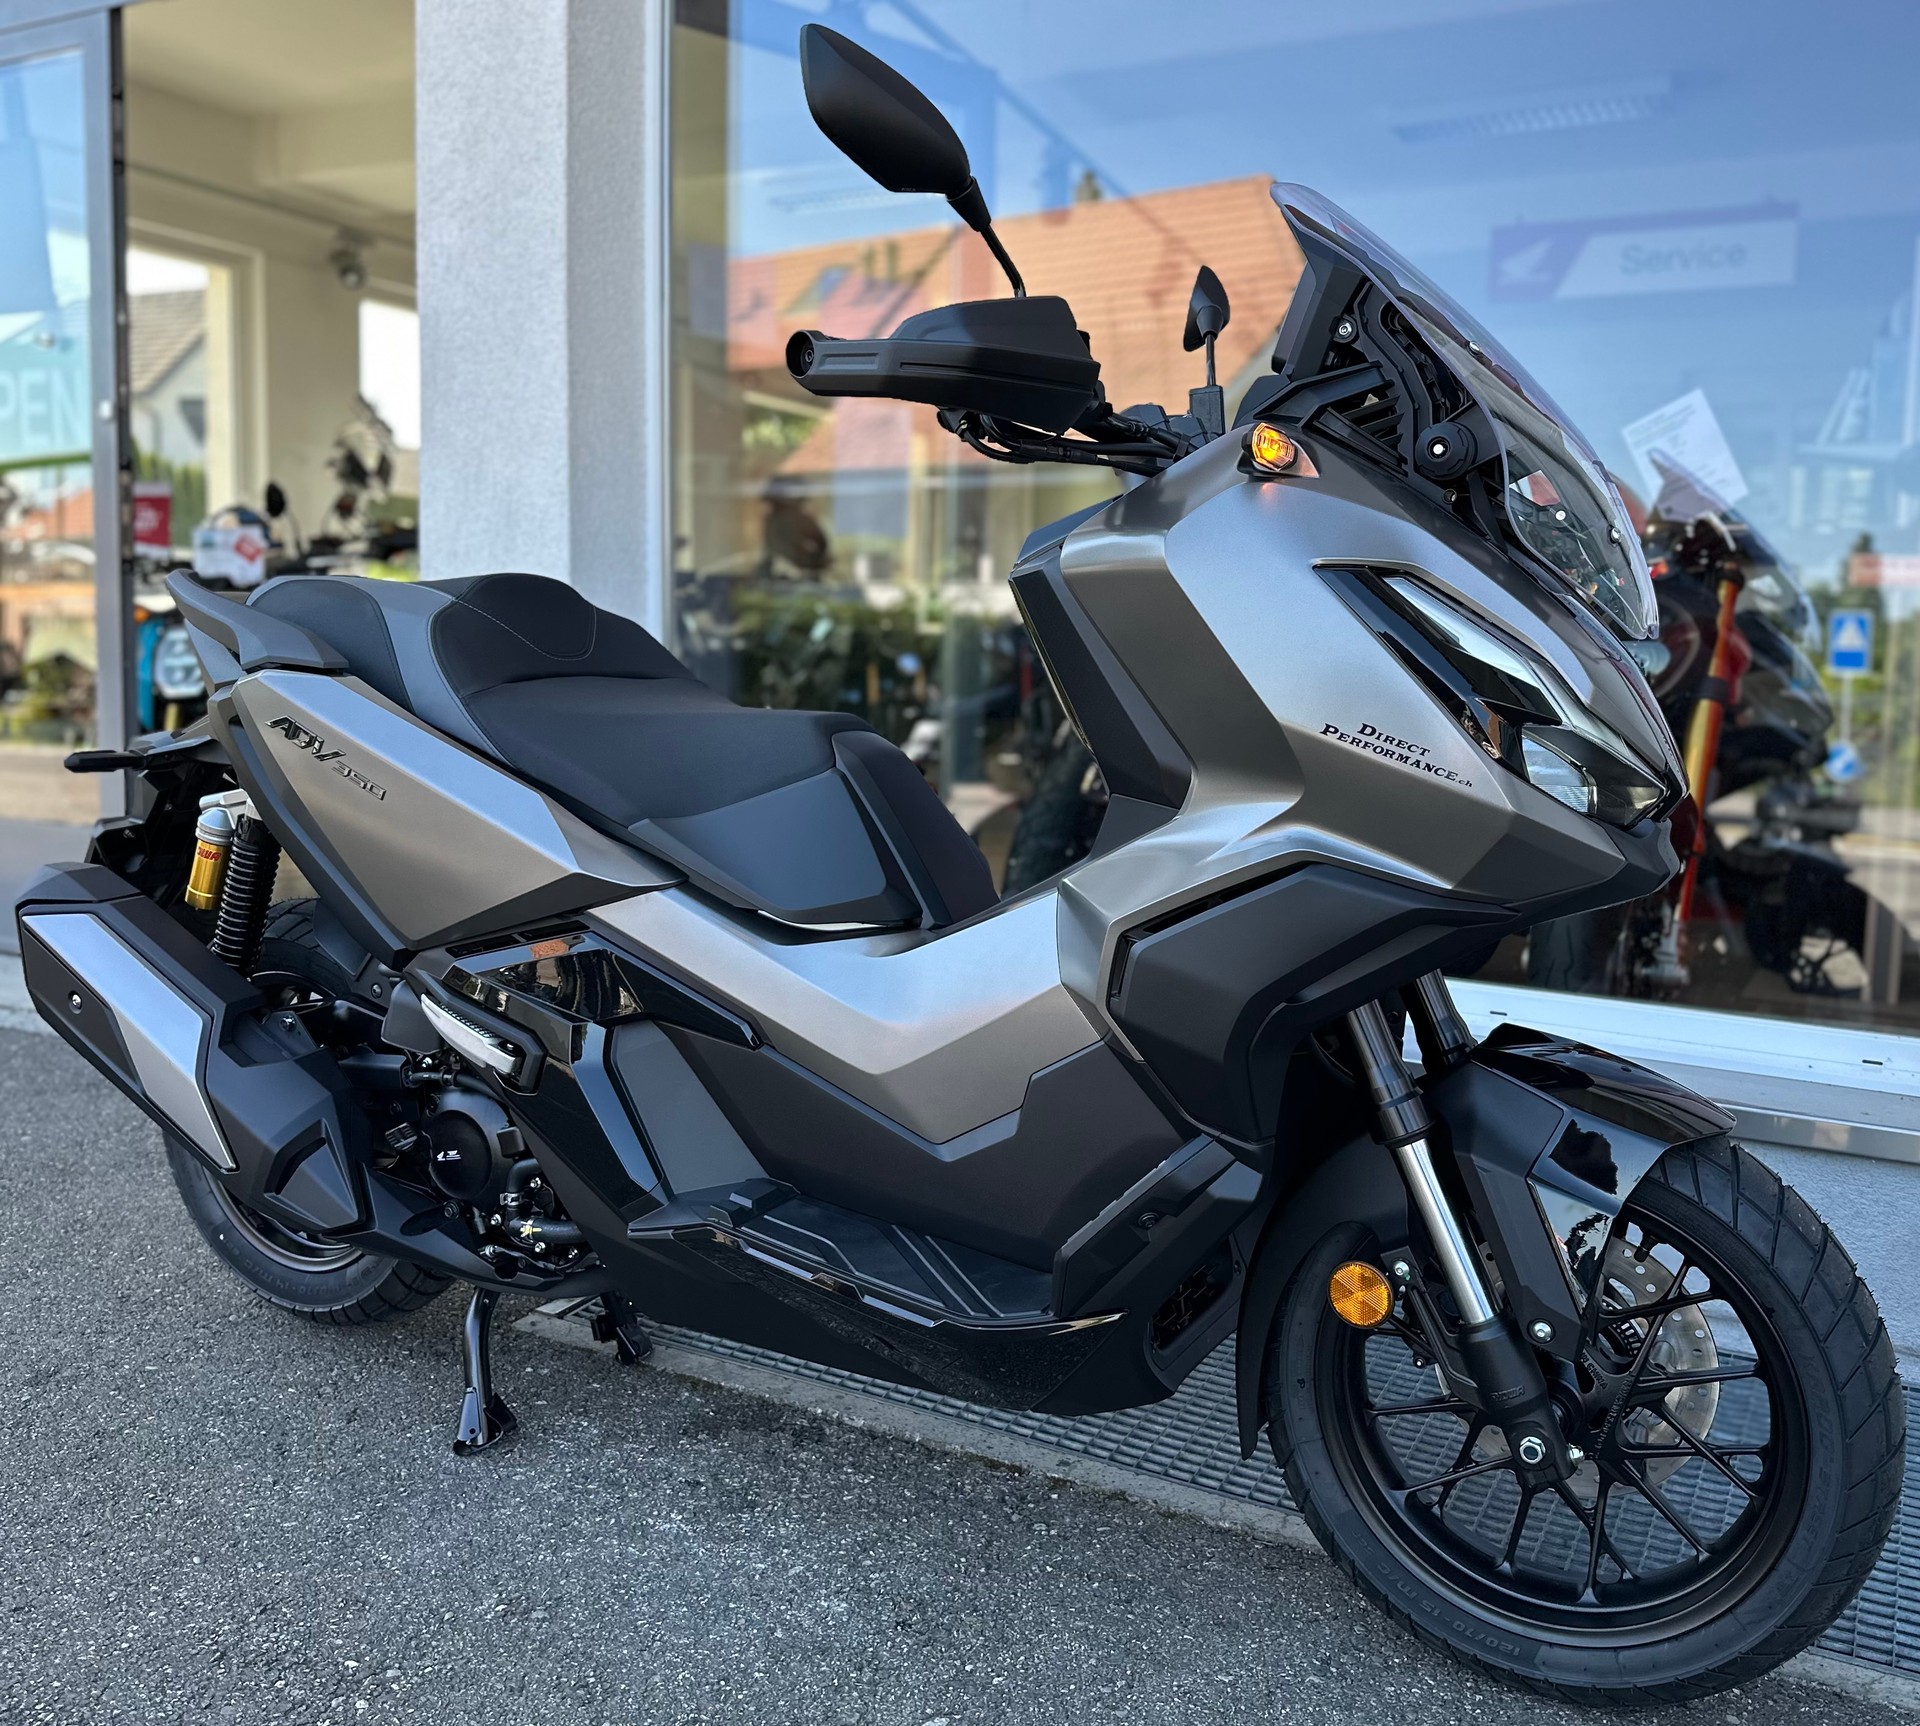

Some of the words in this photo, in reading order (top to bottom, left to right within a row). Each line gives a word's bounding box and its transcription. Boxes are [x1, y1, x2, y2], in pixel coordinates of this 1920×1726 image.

[1620, 240, 1748, 276] Service
[0, 368, 91, 449] PEN
[265, 715, 346, 761] ADV
[331, 760, 387, 800] 350
[1357, 722, 1430, 757] DIRECT
